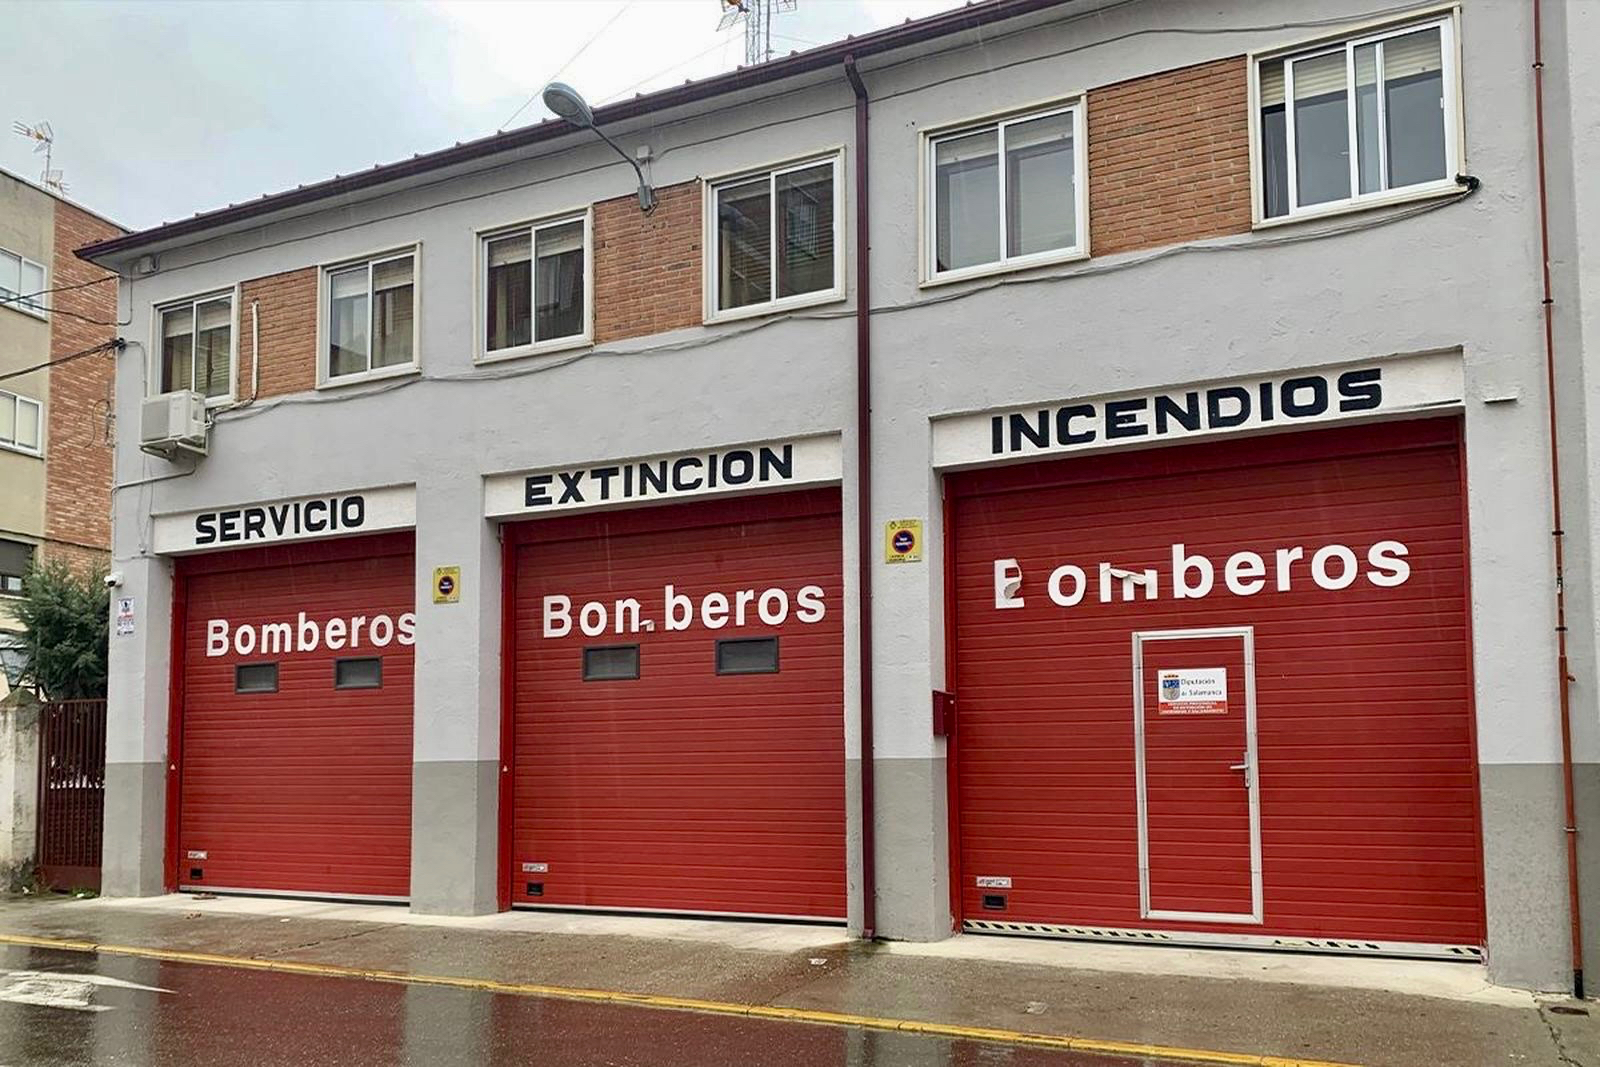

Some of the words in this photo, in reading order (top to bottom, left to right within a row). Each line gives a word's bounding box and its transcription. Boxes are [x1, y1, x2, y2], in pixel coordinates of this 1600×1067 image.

[991, 367, 1382, 455] INCENDIOS
[524, 444, 793, 507] EXTINCION
[195, 495, 365, 545] SERVICIO
[206, 611, 416, 657] Bomberos
[1189, 688, 1222, 697] Salamanca
